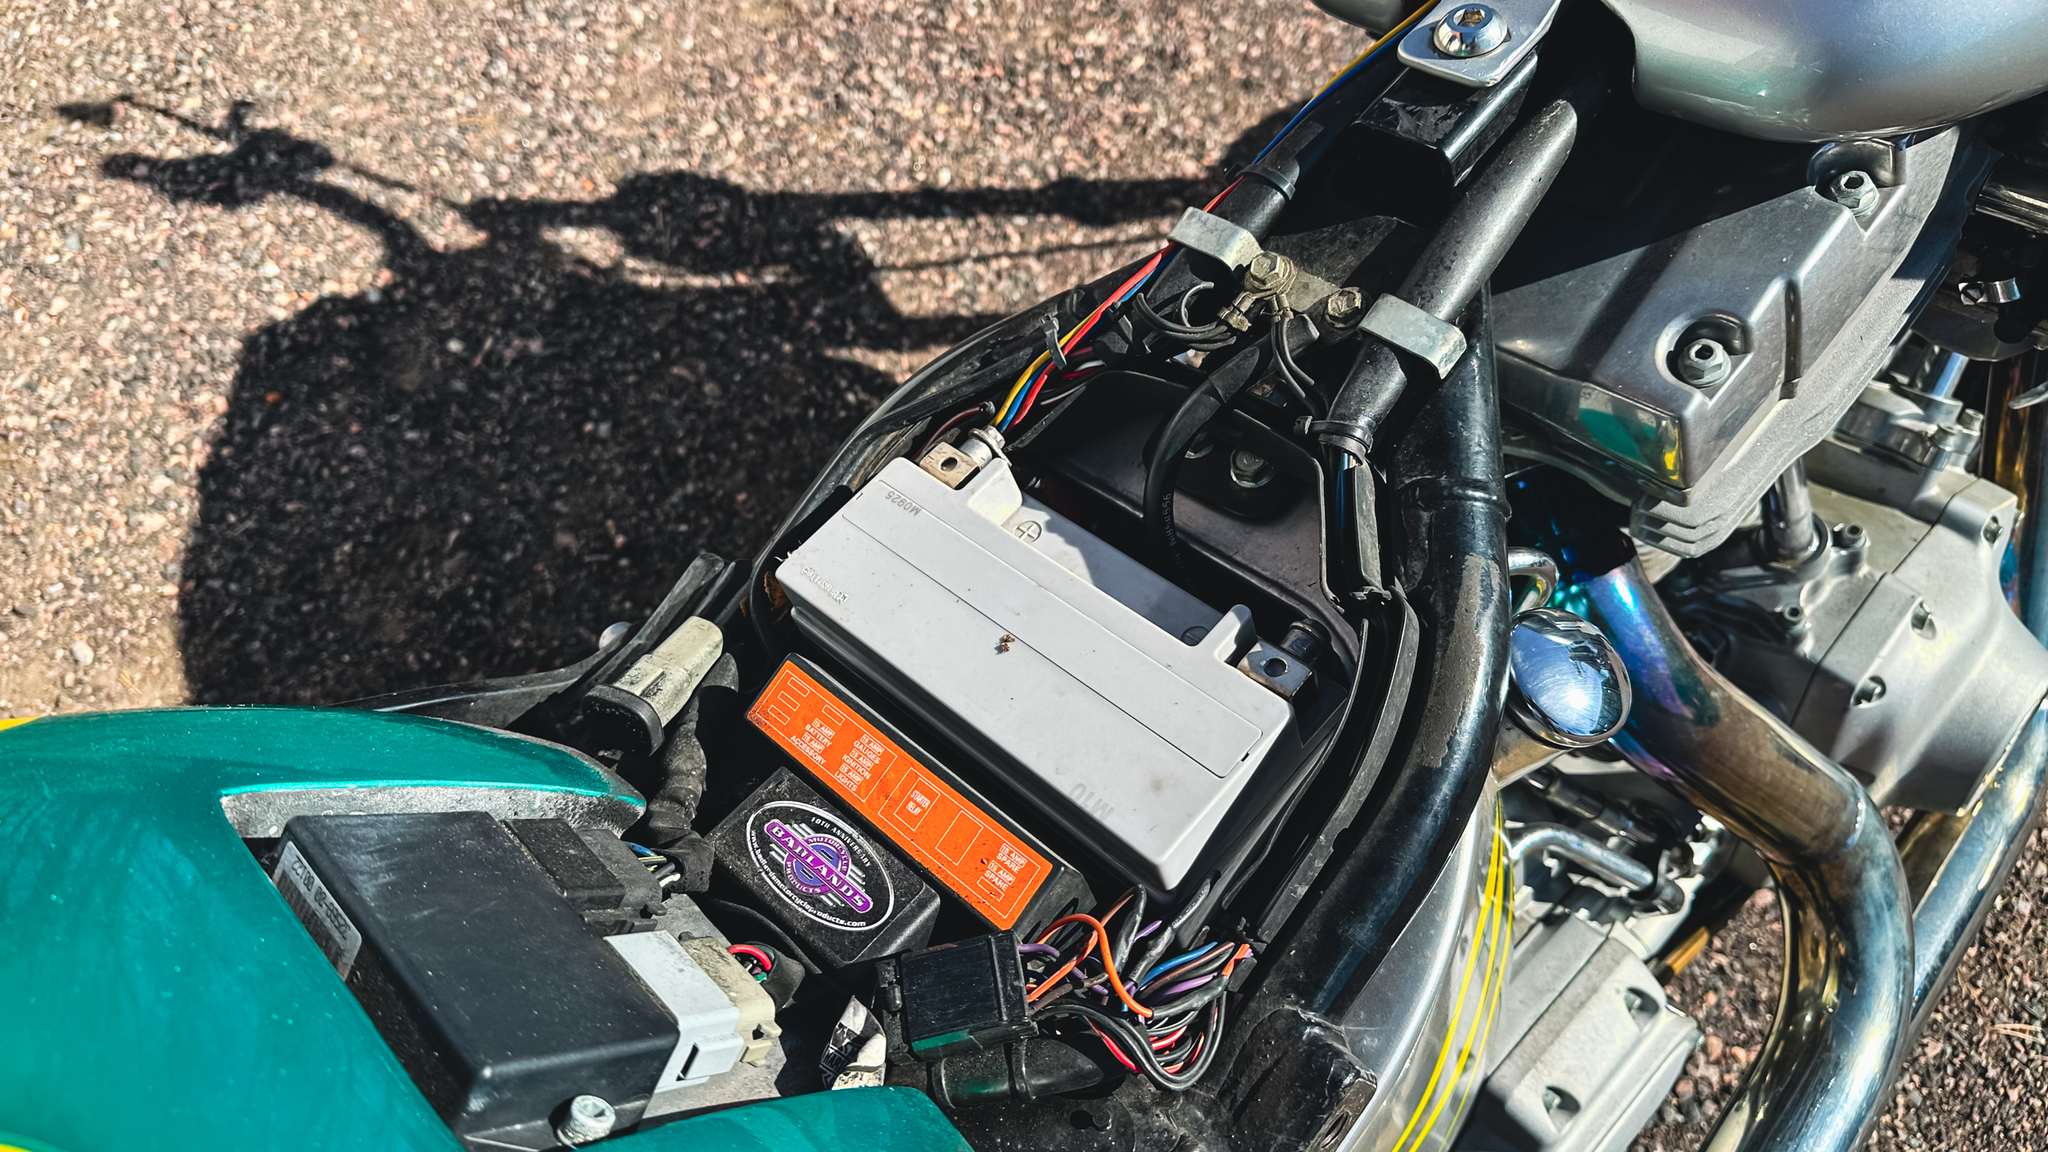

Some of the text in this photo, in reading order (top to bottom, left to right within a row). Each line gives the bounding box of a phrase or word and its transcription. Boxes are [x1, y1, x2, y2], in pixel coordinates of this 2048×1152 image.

[885, 490, 922, 516] M0925
[805, 723, 832, 747] BATTERY
[821, 725, 834, 738] AMP
[790, 735, 826, 765] ACCESSORY
[811, 738, 824, 752] AMP
[853, 740, 881, 764] GAUGES
[869, 741, 883, 755] AMP
[842, 753, 872, 780] IGNITION
[859, 755, 873, 769] AMP
[834, 770, 858, 791] LIGHTS
[849, 770, 862, 783] AMP
[906, 801, 922, 816] RELAY
[910, 789, 931, 809] STARTER
[811, 816, 871, 868] 10TH ANNIVERSARY
[808, 836, 849, 872] MOTORCYCLE
[996, 852, 1021, 874] SPARE
[1010, 852, 1025, 867] AMP
[770, 826, 866, 907] BADLANDS
[998, 869, 1013, 884] AMP
[786, 861, 822, 894] PRODUCTS
[984, 870, 1009, 891] SPARE
